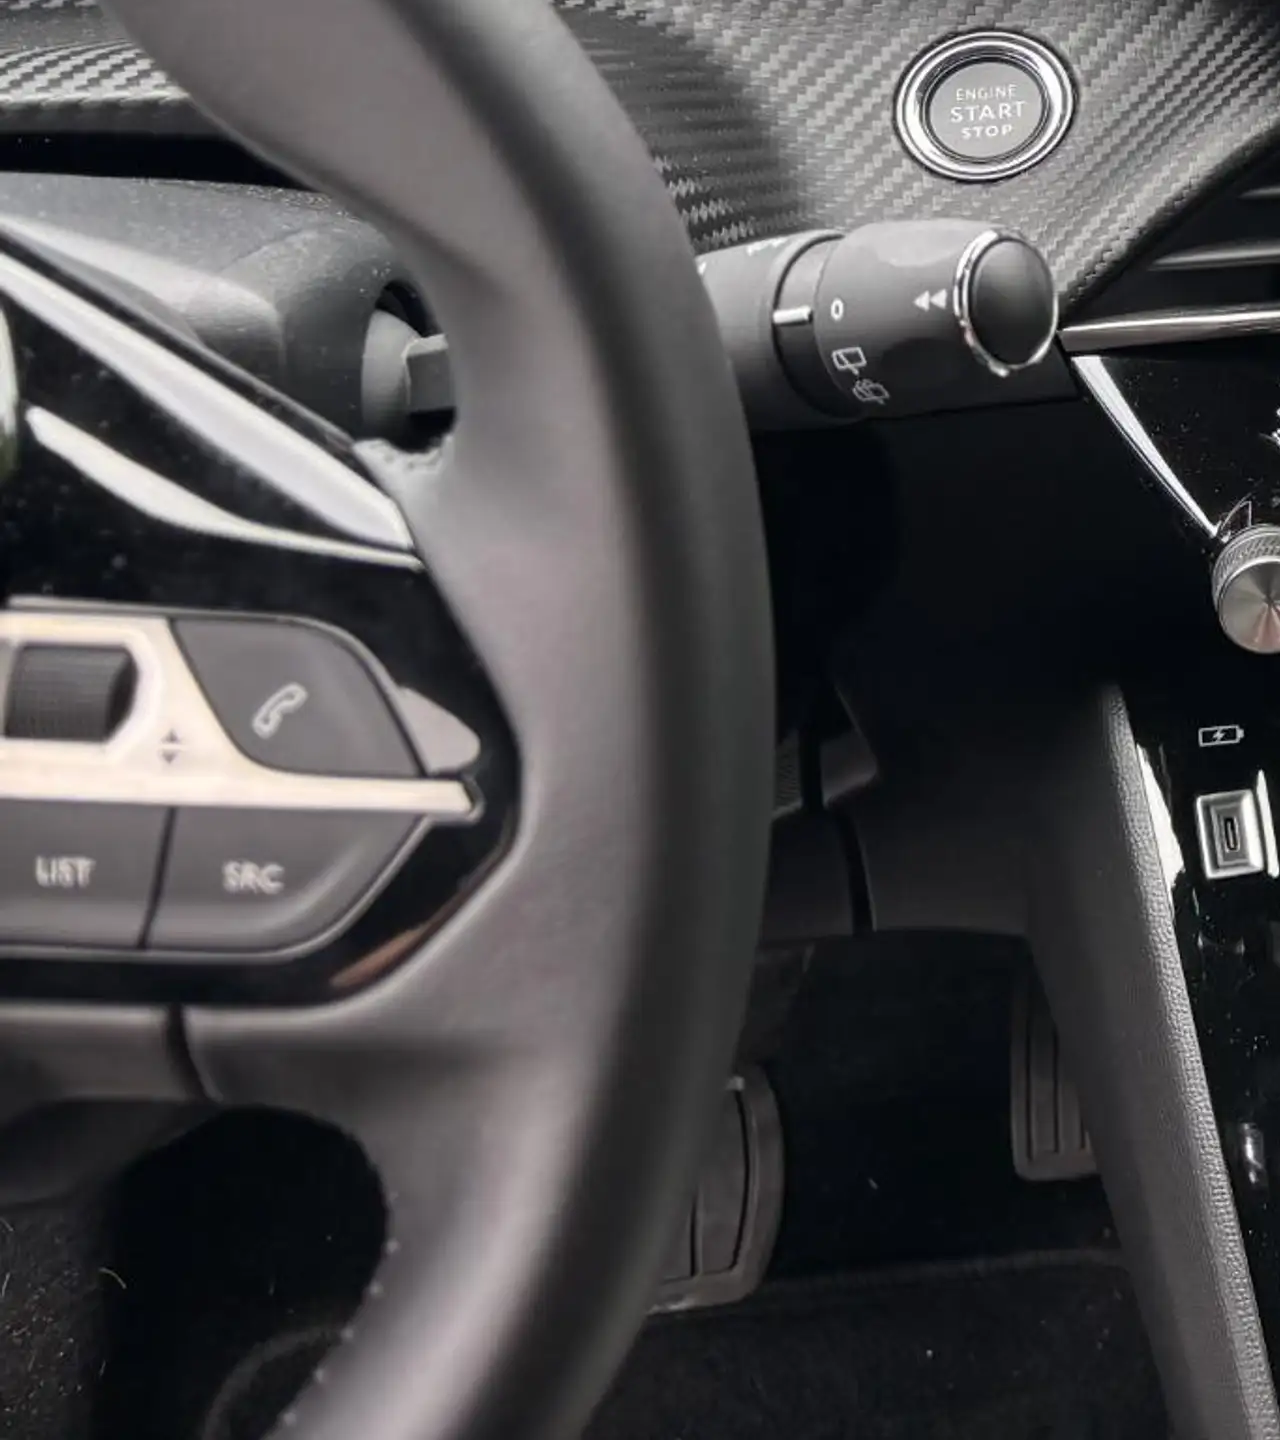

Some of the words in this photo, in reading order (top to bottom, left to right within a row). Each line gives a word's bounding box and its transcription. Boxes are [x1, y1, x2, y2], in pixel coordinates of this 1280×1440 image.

[956, 84, 1018, 101] ENGINE
[950, 101, 1027, 123] START
[961, 124, 1013, 140] STOP
[35, 856, 97, 888] LIST
[221, 860, 285, 895] SRC
